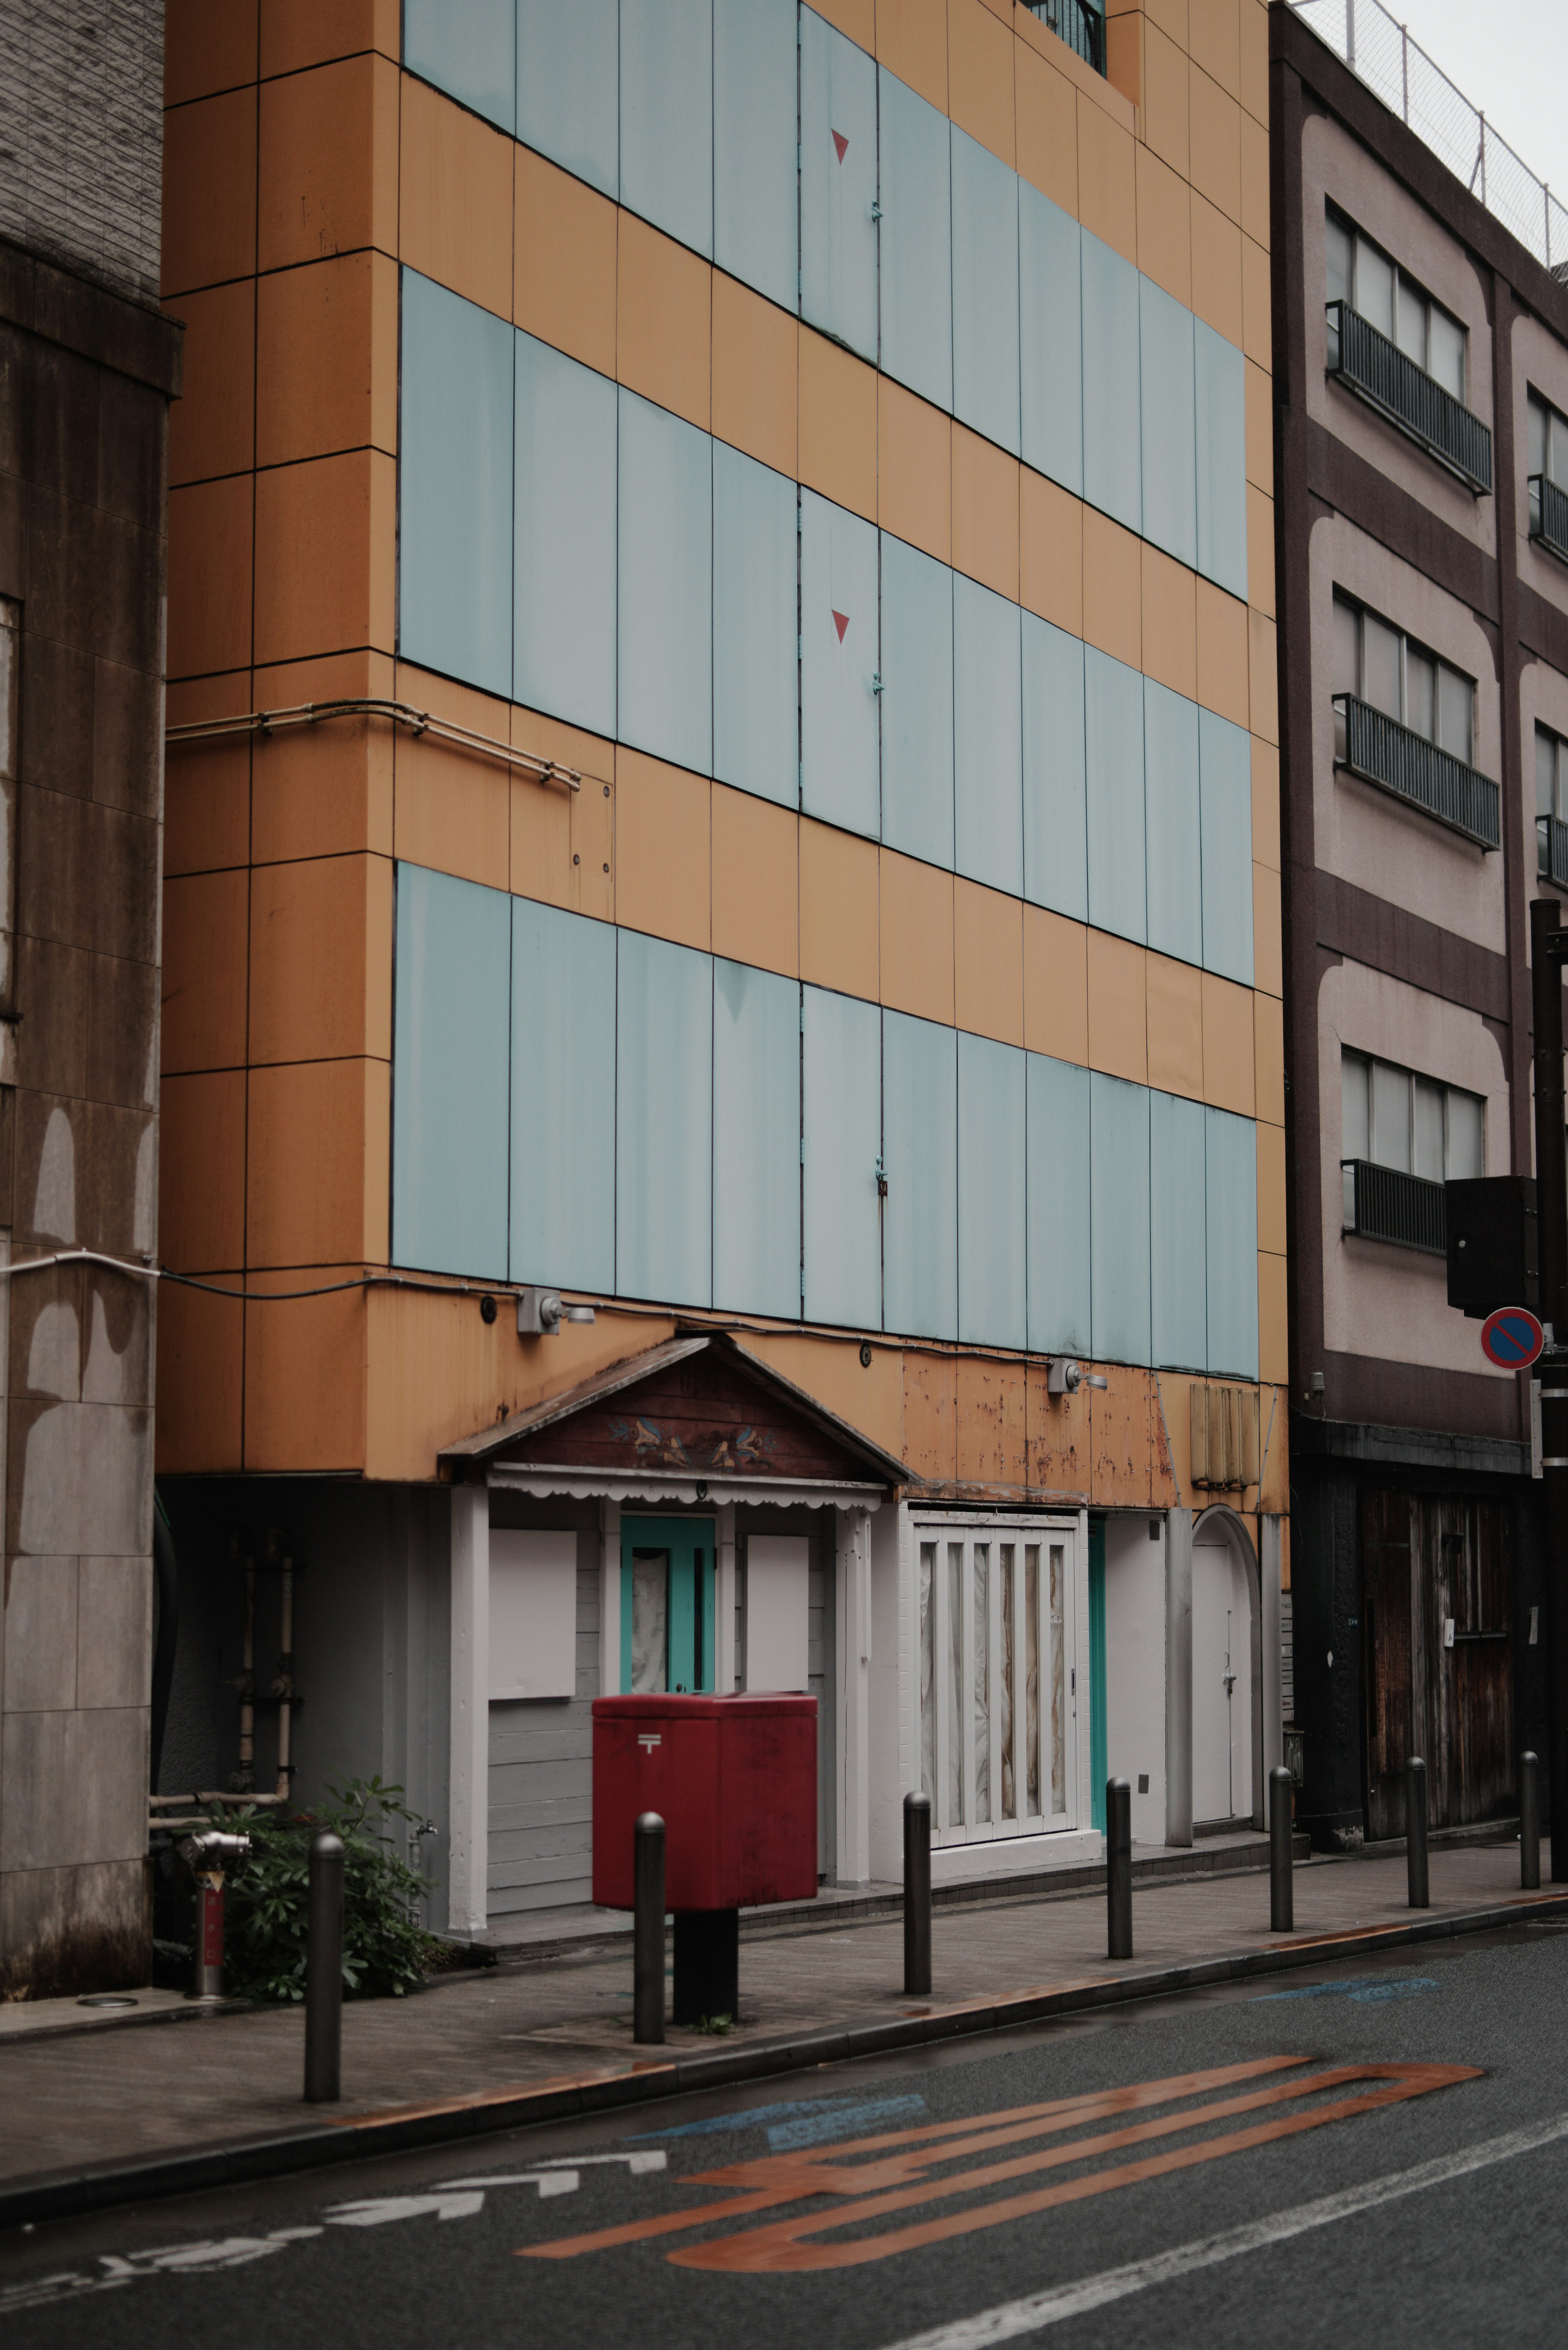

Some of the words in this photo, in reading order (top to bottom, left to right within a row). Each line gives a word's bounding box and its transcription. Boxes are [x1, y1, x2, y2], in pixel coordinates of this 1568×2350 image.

[207, 1897, 216, 1958] 送水口
[514, 2055, 1485, 2273] 40
